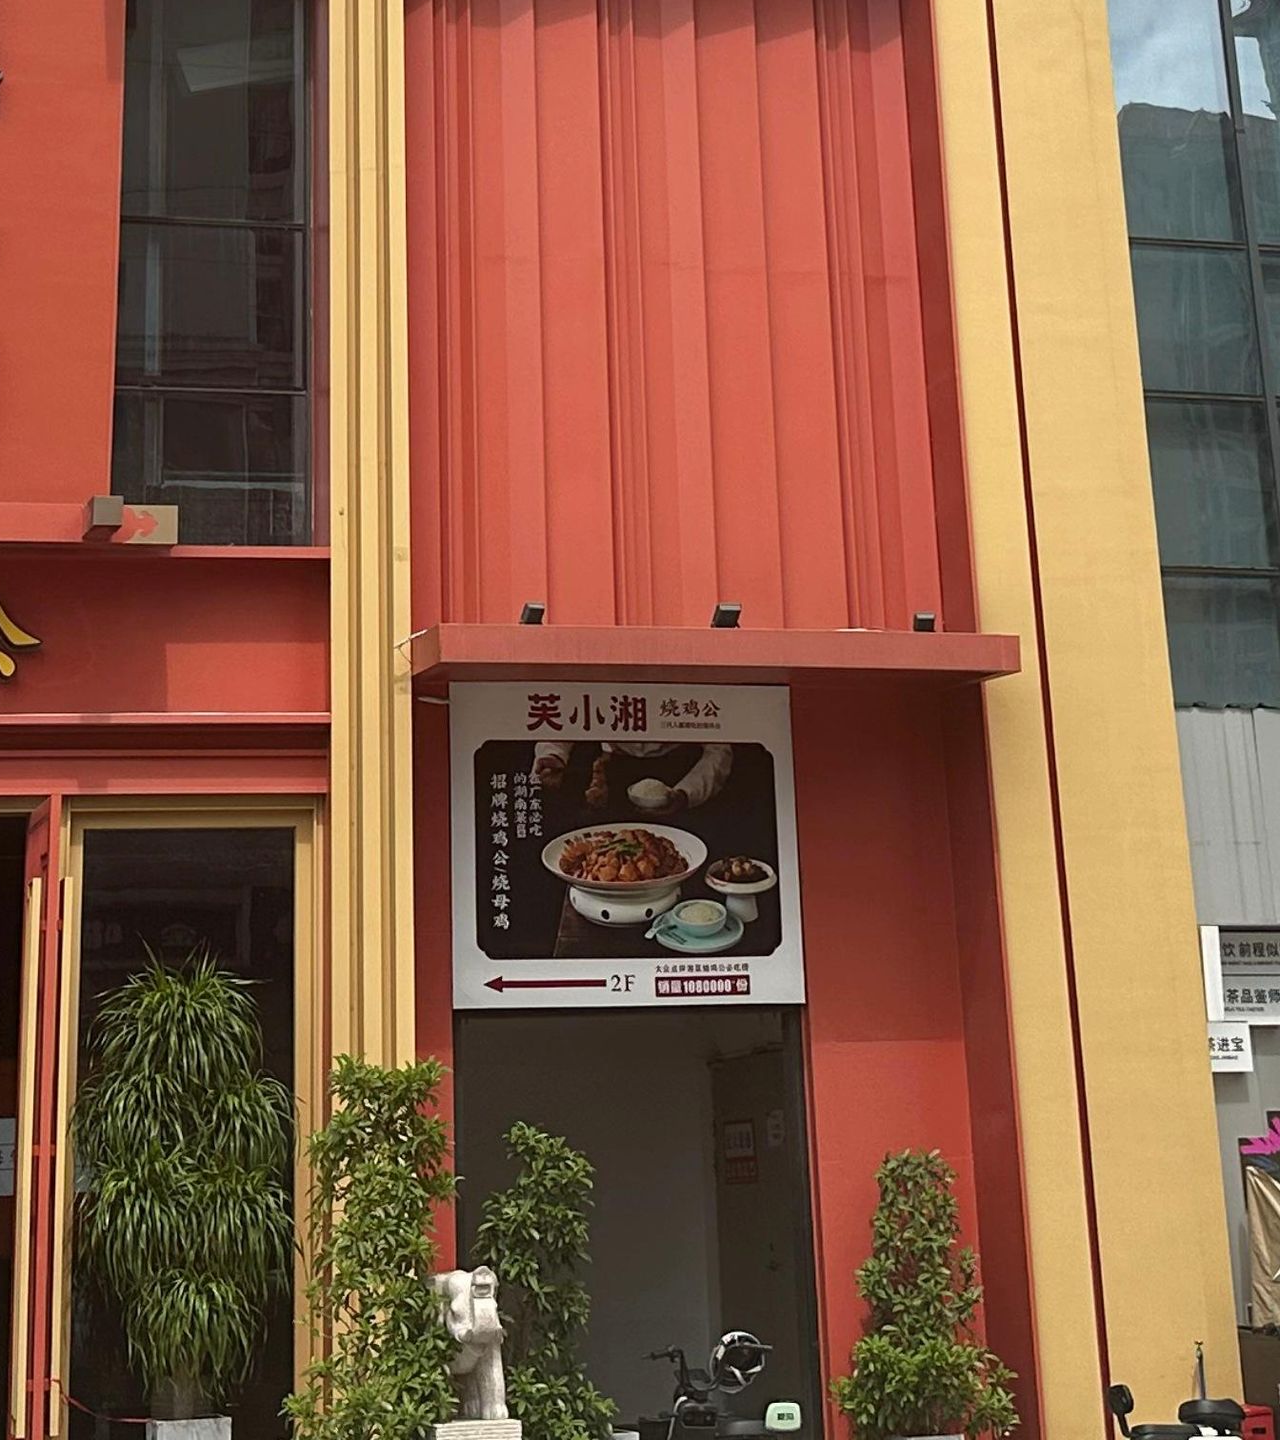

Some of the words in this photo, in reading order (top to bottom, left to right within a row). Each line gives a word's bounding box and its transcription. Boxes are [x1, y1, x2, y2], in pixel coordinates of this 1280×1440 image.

[527, 694, 648, 732] 芙小湘
[659, 698, 721, 718] 烧鸡公
[611, 974, 636, 992] 2F
